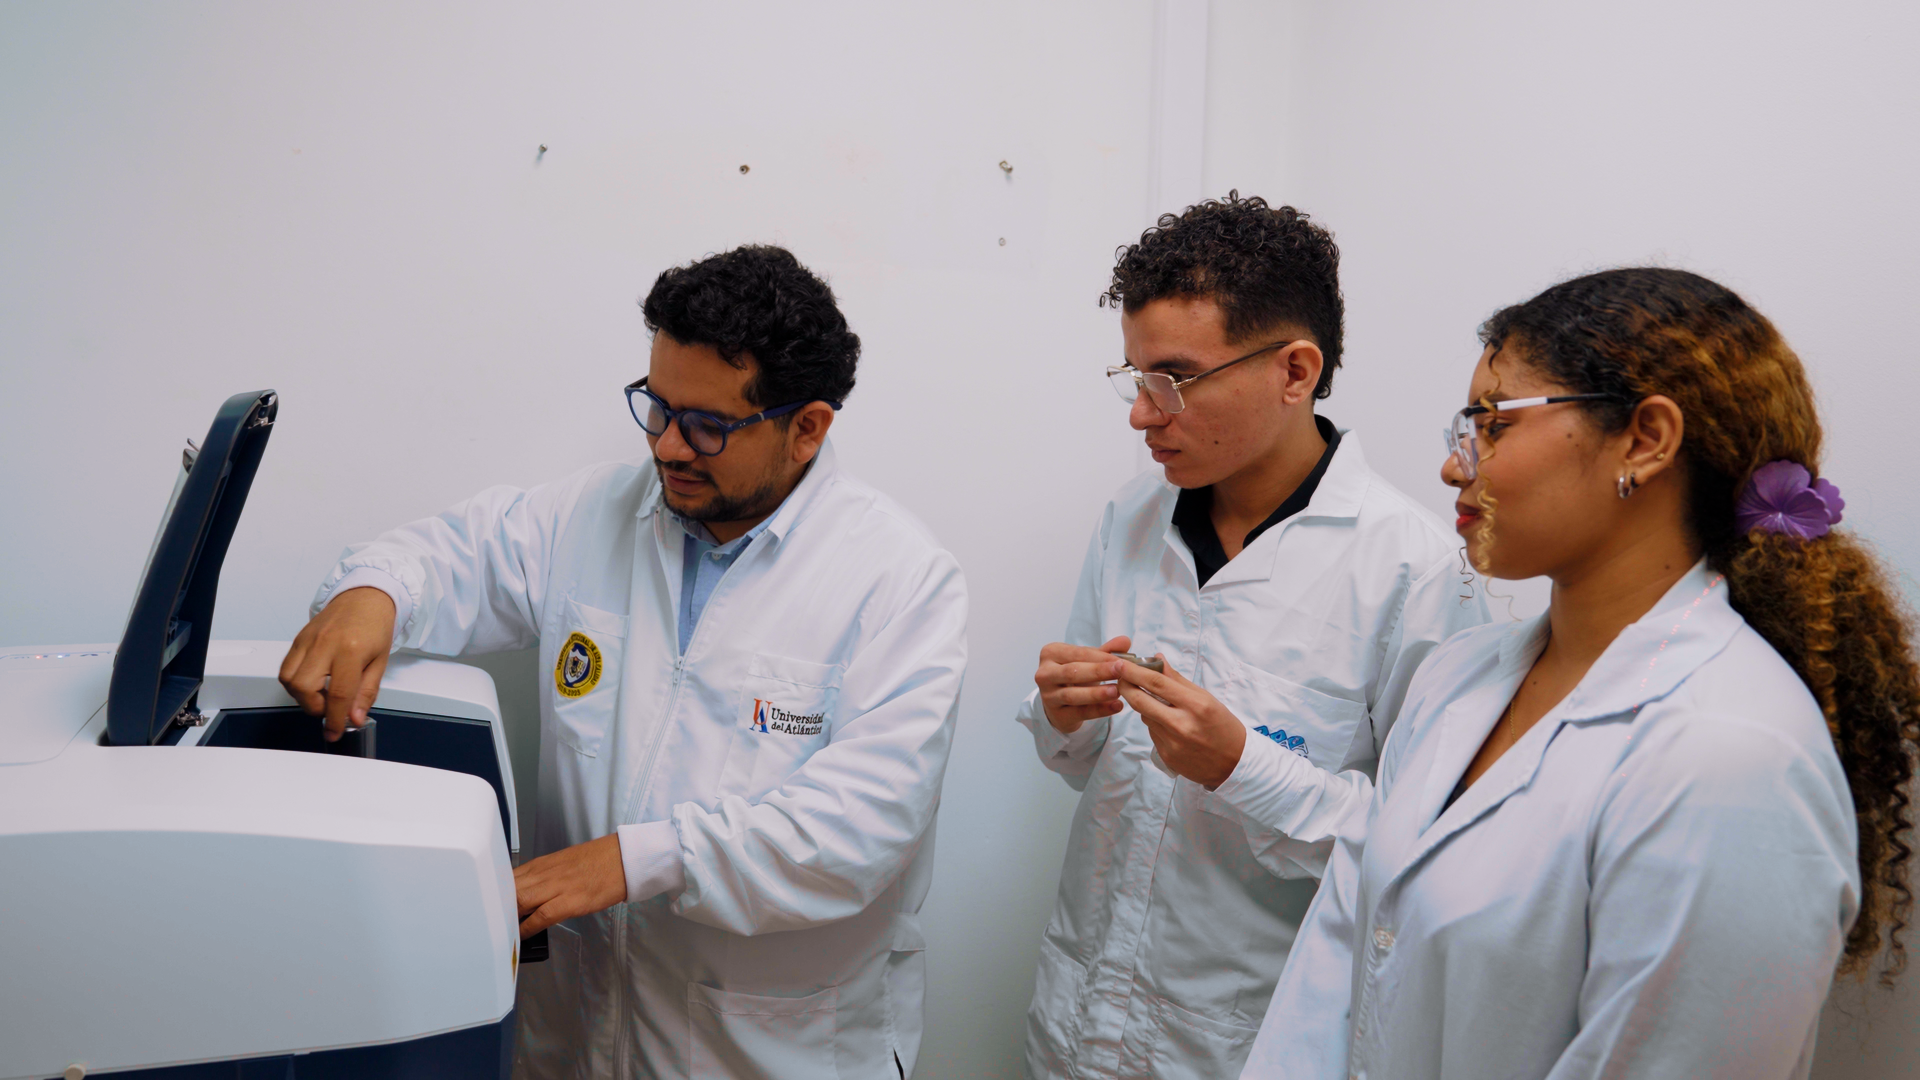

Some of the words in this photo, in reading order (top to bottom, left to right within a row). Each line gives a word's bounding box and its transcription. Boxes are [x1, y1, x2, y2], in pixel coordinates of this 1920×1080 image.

[771, 708, 825, 725] Universidad
[771, 721, 784, 731] del
[784, 723, 822, 735] Atlántico
